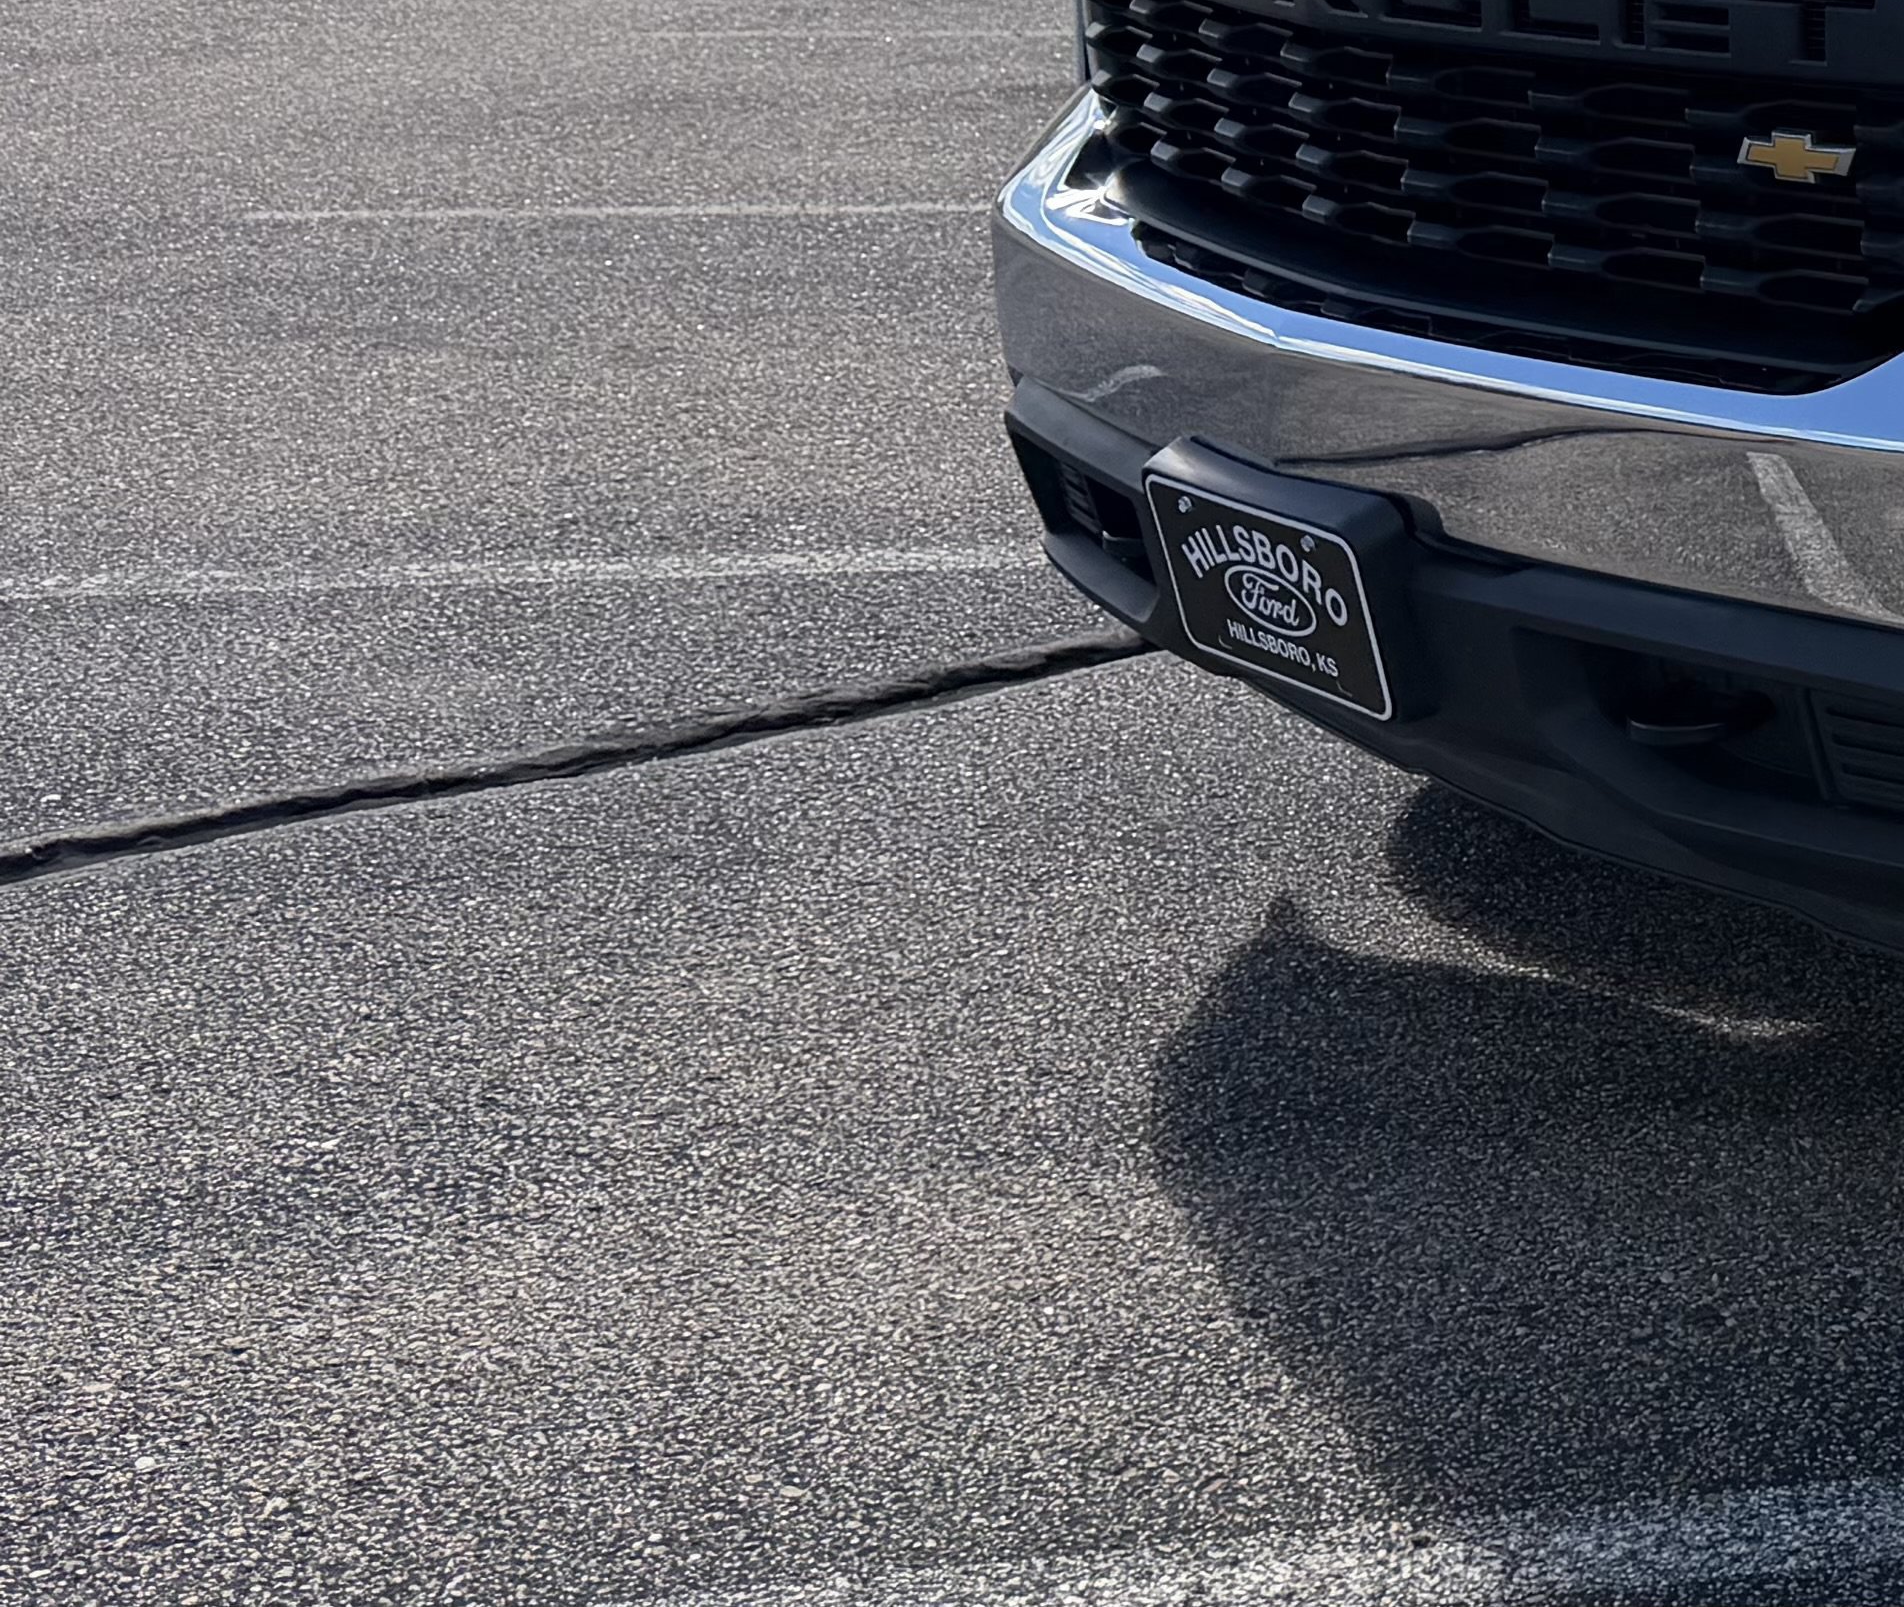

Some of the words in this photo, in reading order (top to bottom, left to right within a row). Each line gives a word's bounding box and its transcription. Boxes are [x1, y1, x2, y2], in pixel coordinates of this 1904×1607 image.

[1182, 525, 1348, 626] HILLSBORO
[1241, 573, 1299, 626] Ford
[1227, 619, 1316, 672] HILLSBORO,
[1316, 652, 1339, 677] KS
